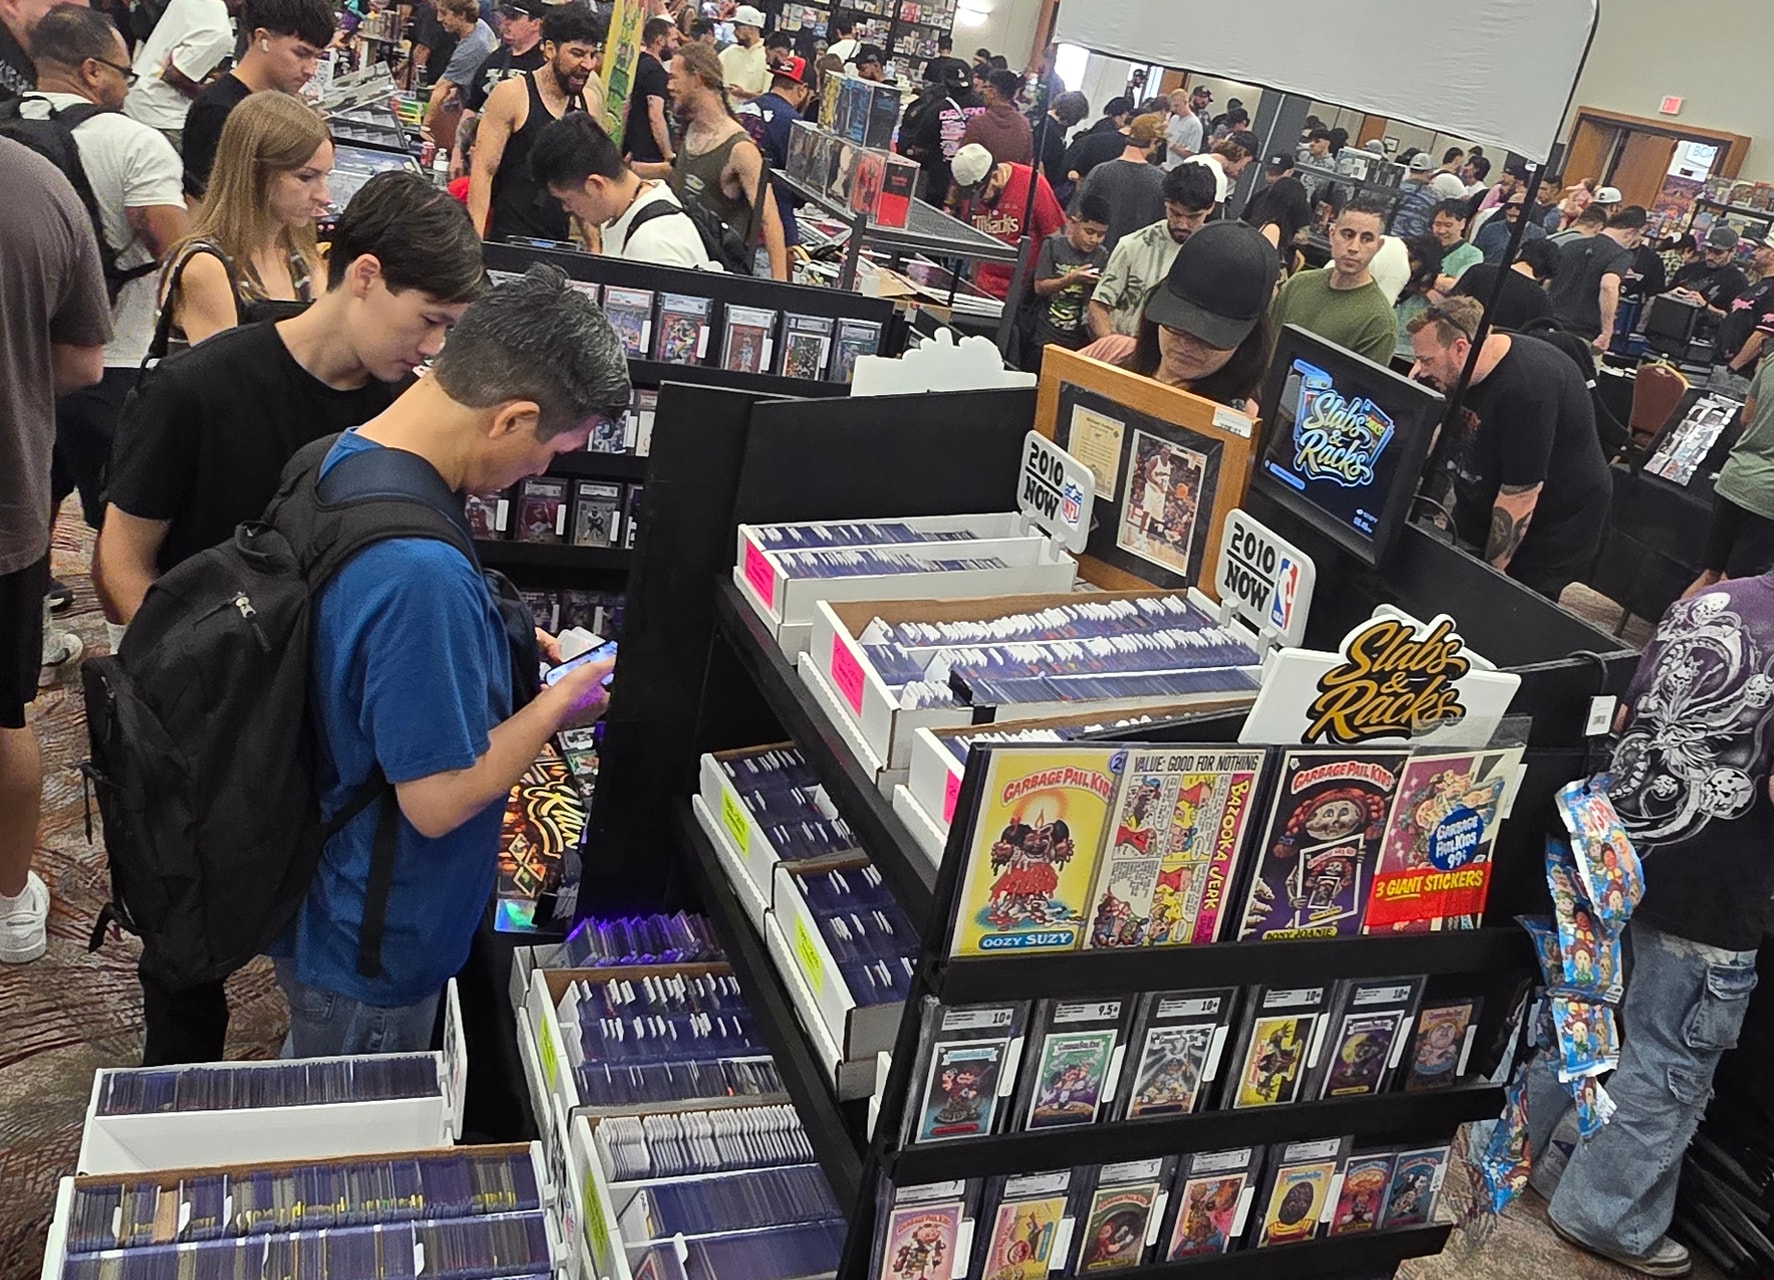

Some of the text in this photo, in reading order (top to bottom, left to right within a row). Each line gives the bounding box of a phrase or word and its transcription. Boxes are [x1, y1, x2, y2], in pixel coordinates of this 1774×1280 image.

[1303, 391, 1371, 447] Slabs
[1329, 429, 1346, 447] &
[1029, 441, 1064, 487] 2010
[1297, 429, 1373, 481] Racks
[1023, 475, 1060, 521] NOW
[1231, 521, 1276, 574] 2010
[1224, 561, 1271, 613] NOW
[1322, 620, 1467, 685] Slabs
[1380, 671, 1411, 693] &
[1307, 674, 1462, 740] Racks
[1003, 768, 1115, 801] GARBAGE PAIL KIDS
[1134, 754, 1259, 772] VALUE: GOOD FOR NOTHING
[1293, 762, 1394, 790] GARBAGE PAIL KIDS
[1213, 779, 1250, 862] BAZOOKA
[1436, 814, 1478, 839] GARBAGE
[1202, 866, 1229, 910] JERK
[1375, 870, 1484, 897] 3 GIANT STICKERS
[980, 931, 1071, 948] OOZY SUZY
